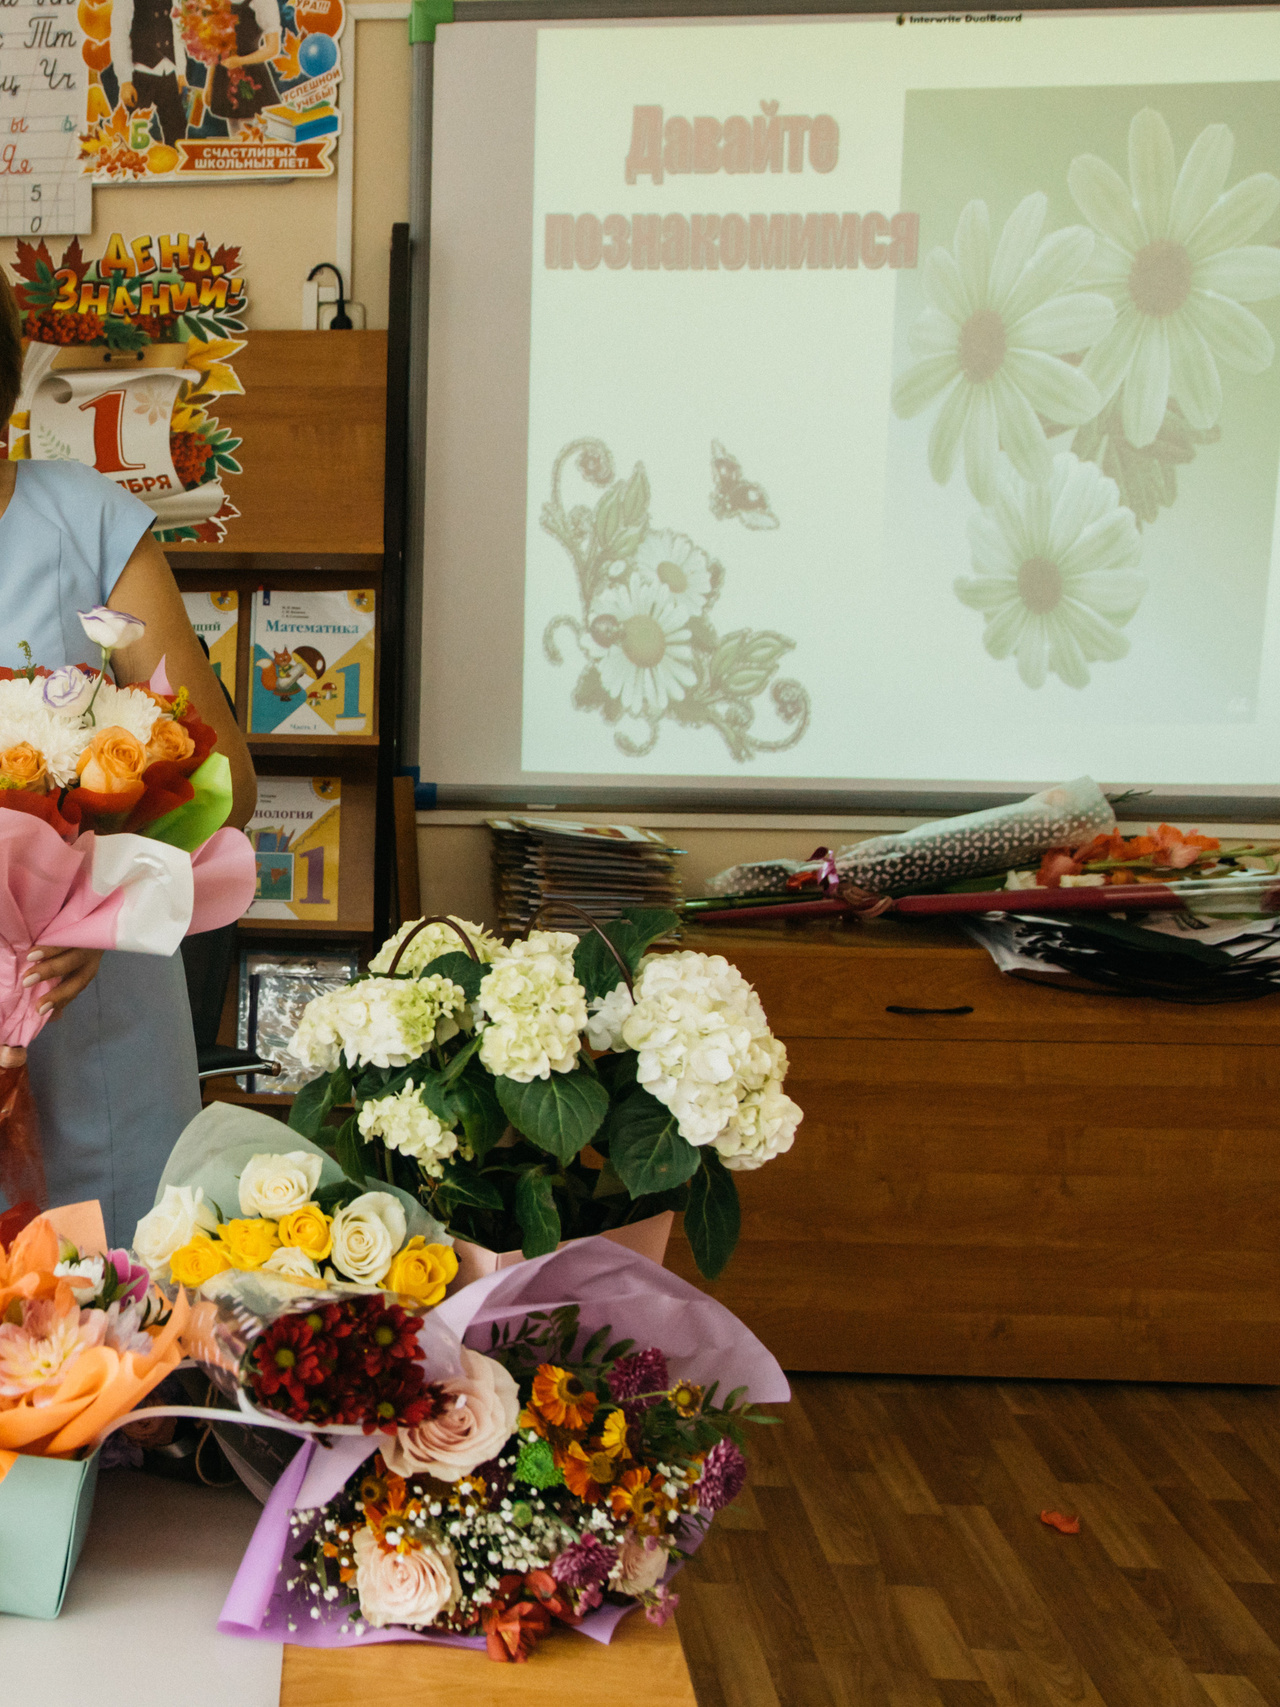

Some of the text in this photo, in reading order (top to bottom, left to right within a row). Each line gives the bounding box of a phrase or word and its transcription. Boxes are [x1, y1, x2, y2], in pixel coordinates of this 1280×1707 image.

[24, 15, 77, 48] Тт
[909, 13, 1023, 23] Interwrite DualBoard
[39, 58, 75, 89] Чч
[11, 117, 29, 134] ы
[202, 147, 297, 158] СЧАСТЛИВЫХ
[625, 99, 839, 185] Давайте
[194, 158, 310, 169] ШКОЛЬНЫХ ЛЕТ!
[30, 184, 42, 202] 5
[96, 232, 211, 278] ДЕНЬ
[544, 211, 920, 270] познакомимся
[78, 389, 146, 474] 1
[266, 619, 359, 634] Математика
[335, 662, 366, 719] 1
[299, 846, 331, 904] 1
